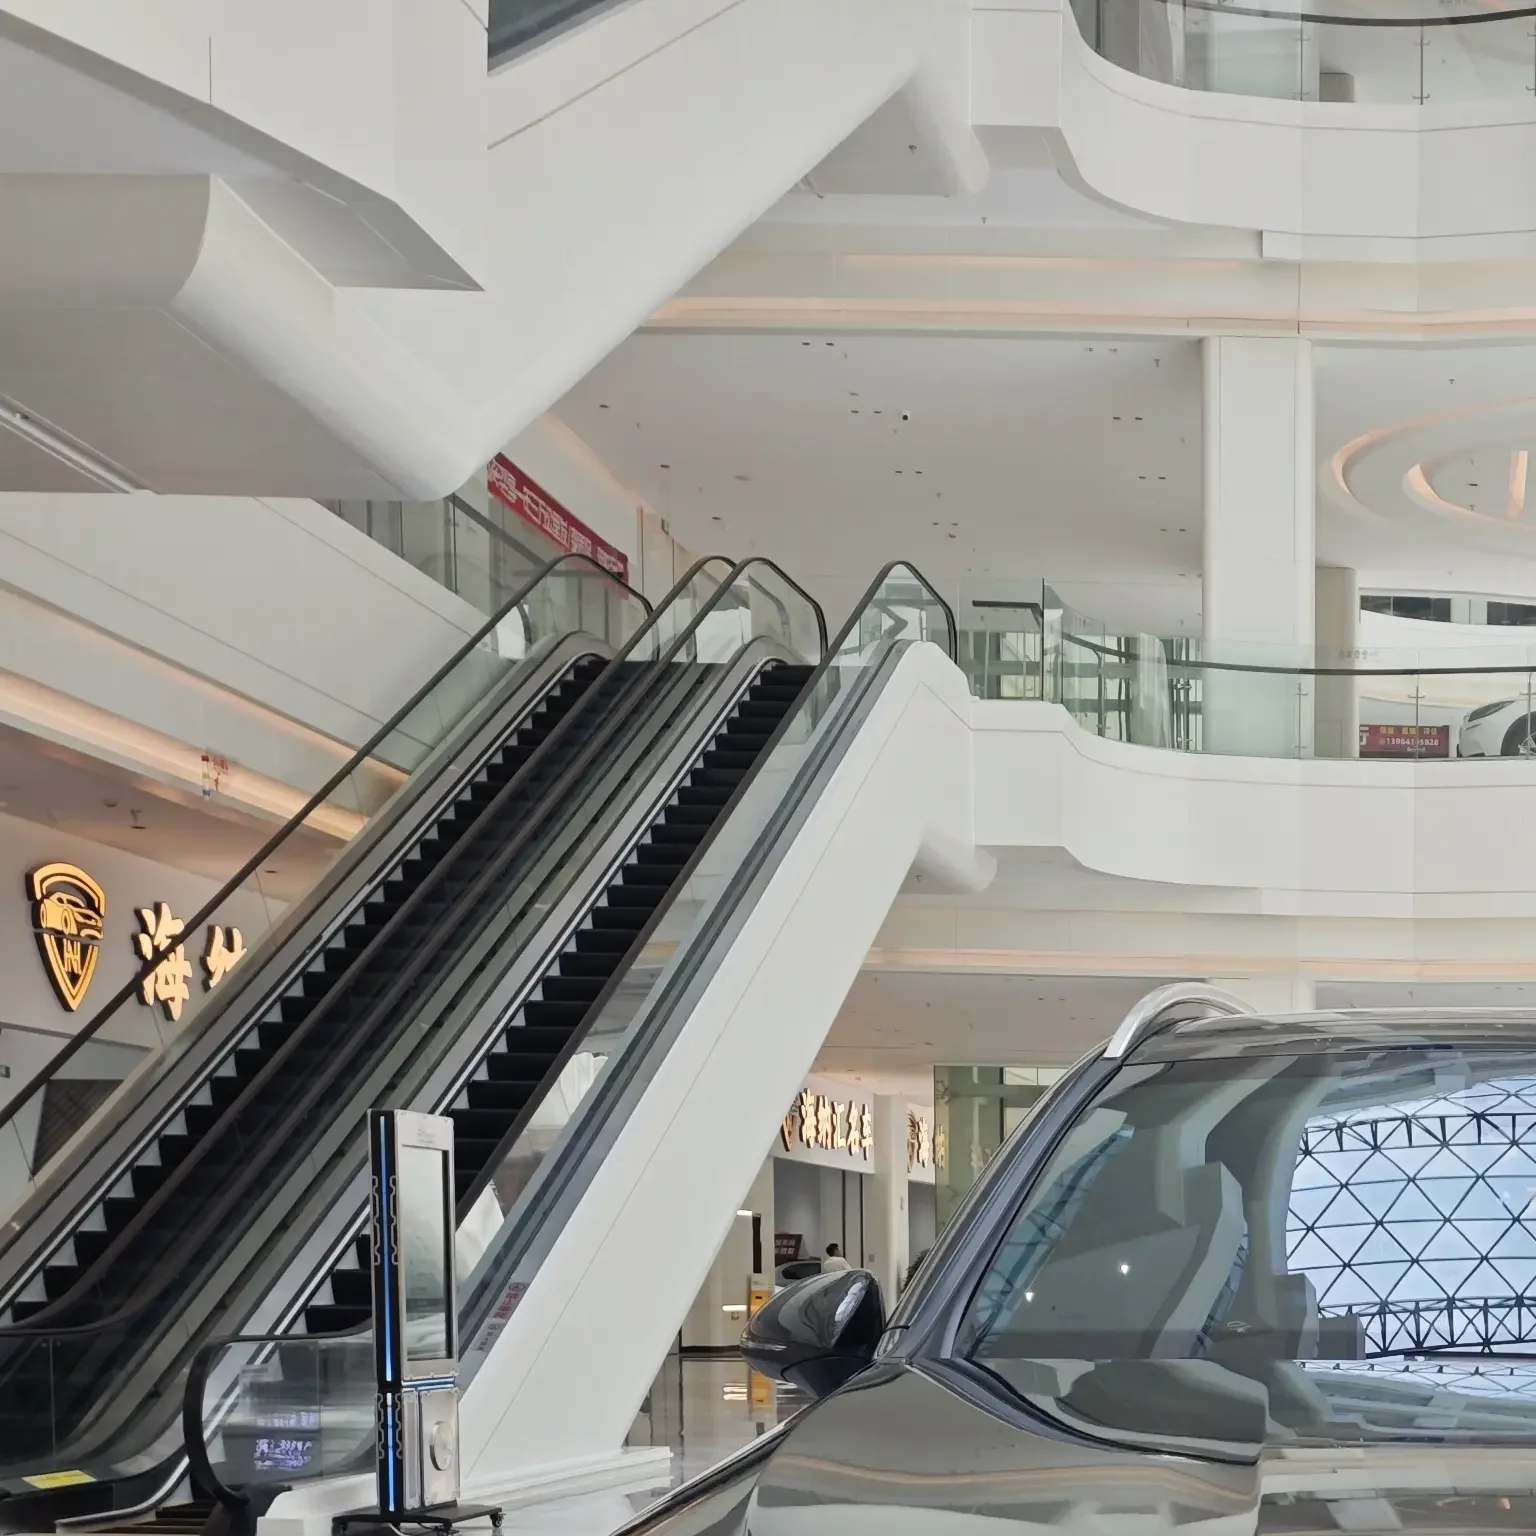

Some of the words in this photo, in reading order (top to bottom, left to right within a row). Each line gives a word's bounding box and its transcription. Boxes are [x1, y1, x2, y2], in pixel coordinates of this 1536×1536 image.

[799, 1087, 874, 1161] 海纳汇名车
